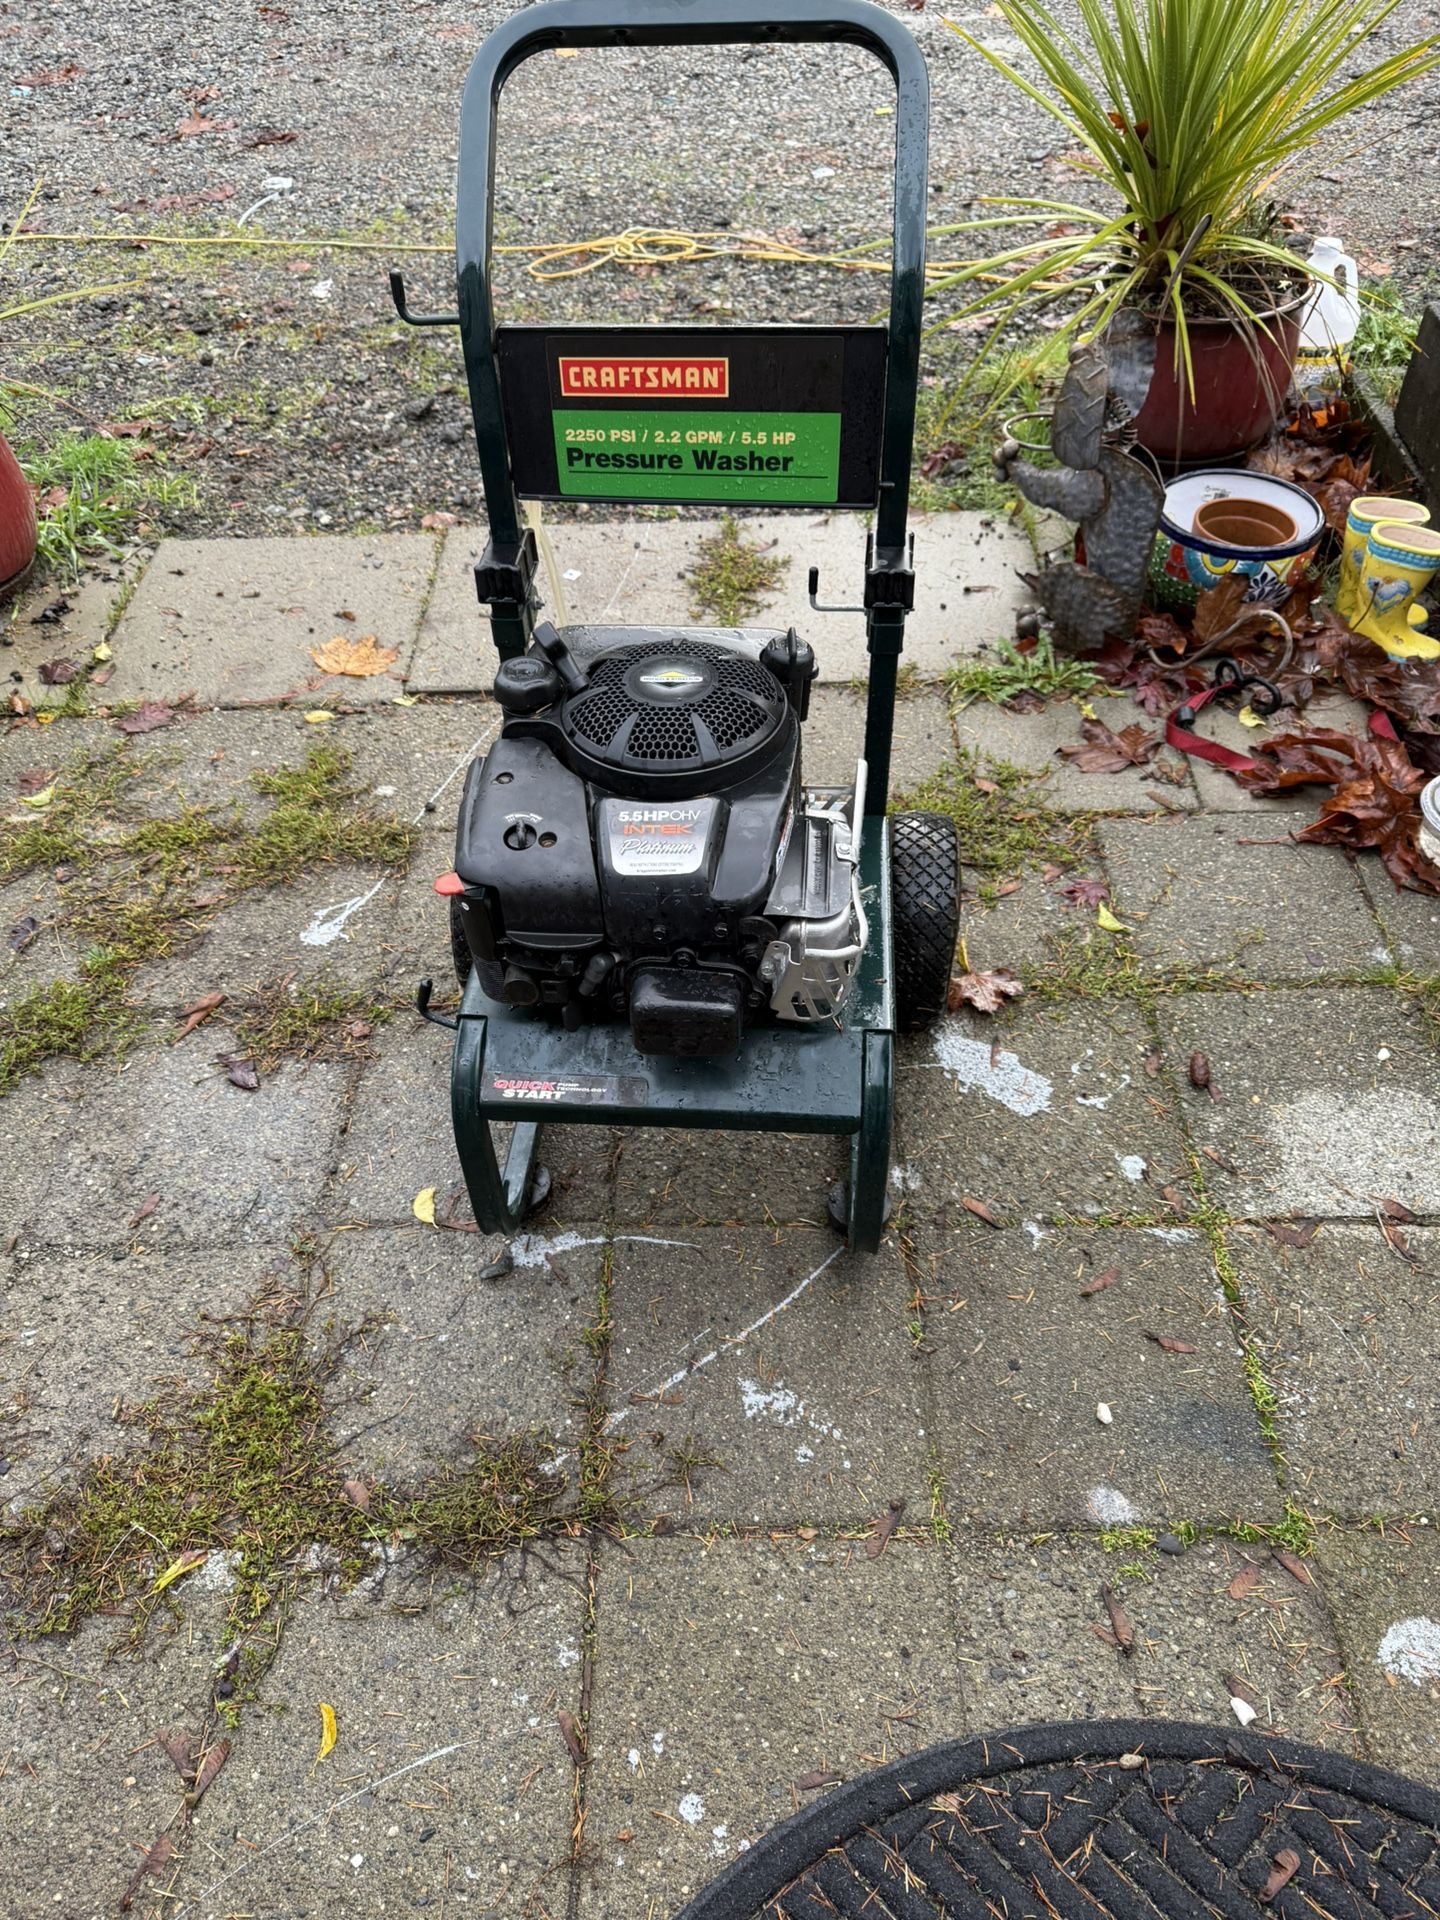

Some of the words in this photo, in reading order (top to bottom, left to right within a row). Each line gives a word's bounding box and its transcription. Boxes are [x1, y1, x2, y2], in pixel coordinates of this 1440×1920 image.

[568, 366, 719, 389] CRAFTSMAN
[565, 429, 606, 442] 2250
[610, 430, 637, 443] PSI
[642, 429, 649, 443] /
[654, 430, 682, 443] 2.2
[685, 430, 723, 444] GPM
[729, 431, 736, 445] /
[741, 431, 768, 445] 5.5
[772, 431, 796, 445] HP
[566, 447, 683, 469] Pressure
[692, 449, 794, 472] Washer
[623, 823, 694, 836] INTEK
[620, 838, 697, 856] Platinum
[493, 1079, 557, 1090] QUICK
[502, 1089, 566, 1100] START
